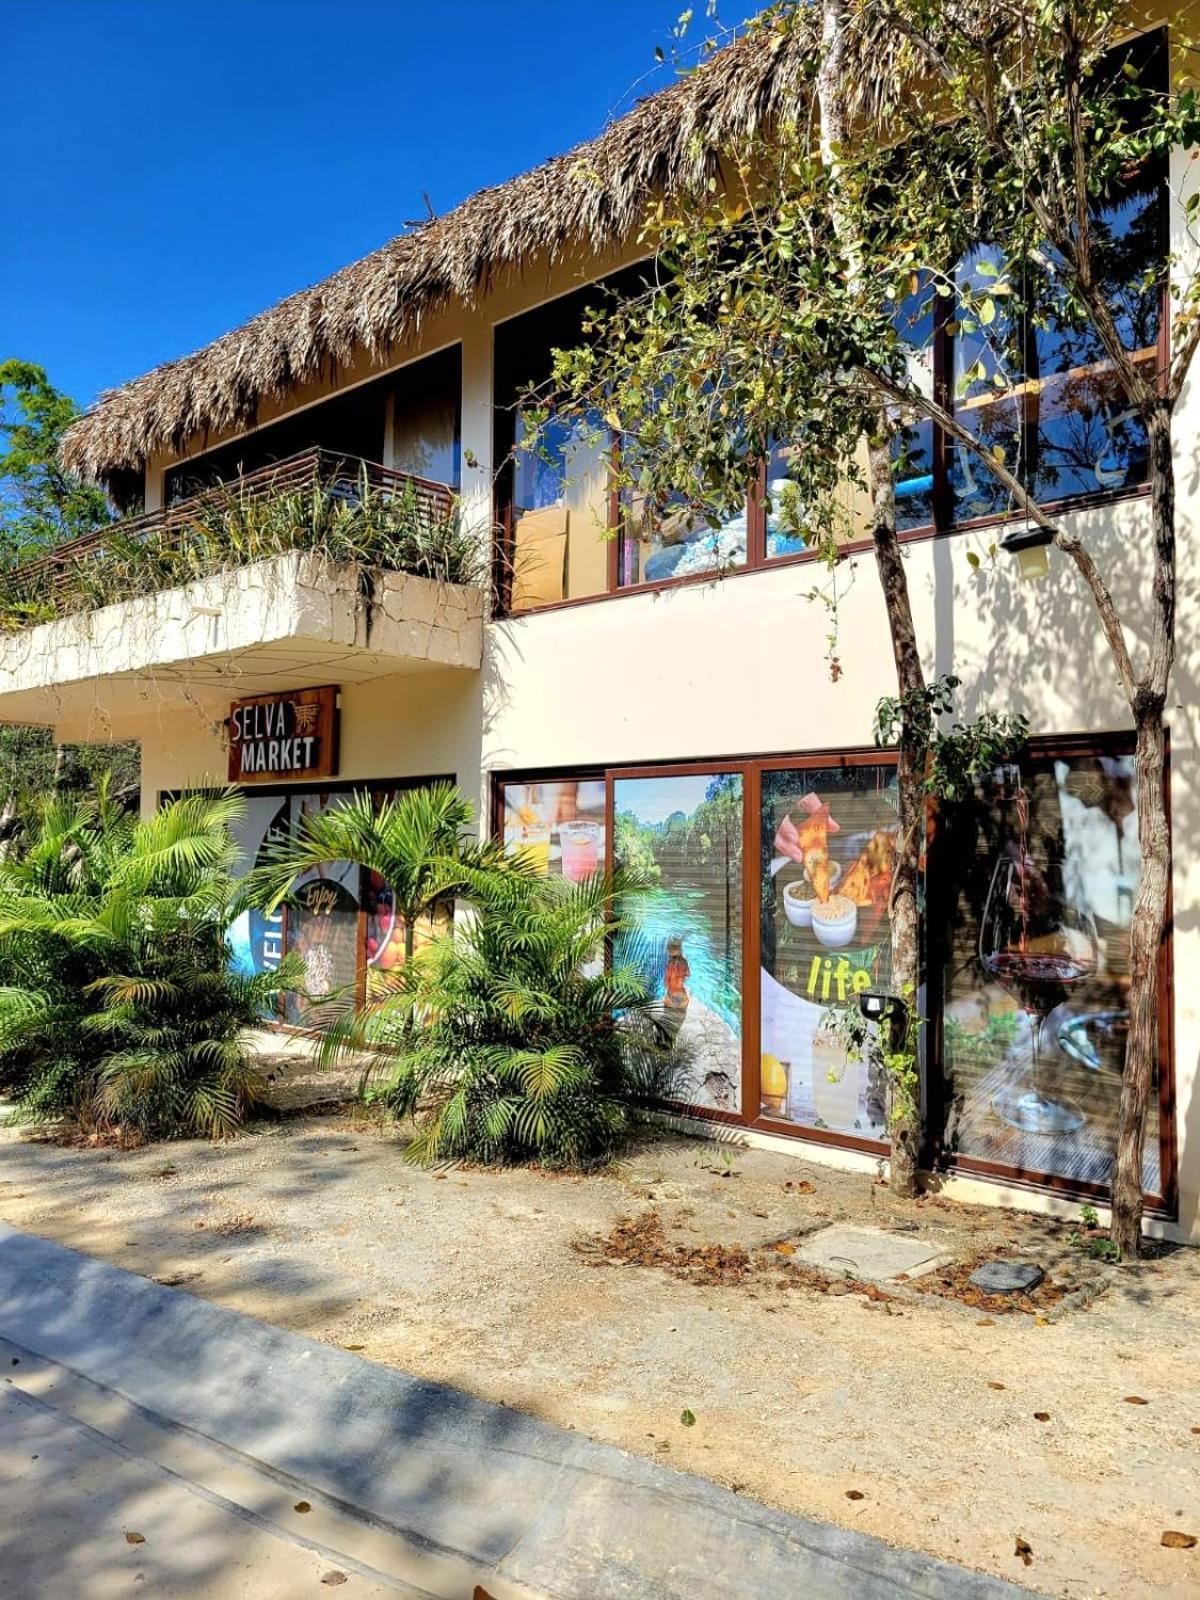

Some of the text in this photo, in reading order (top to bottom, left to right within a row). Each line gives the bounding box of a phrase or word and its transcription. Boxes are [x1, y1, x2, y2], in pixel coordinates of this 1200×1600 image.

[232, 702, 285, 741] SELVA
[240, 737, 314, 772] MARKET
[306, 885, 338, 915] Enjoy
[806, 955, 872, 1001] life
